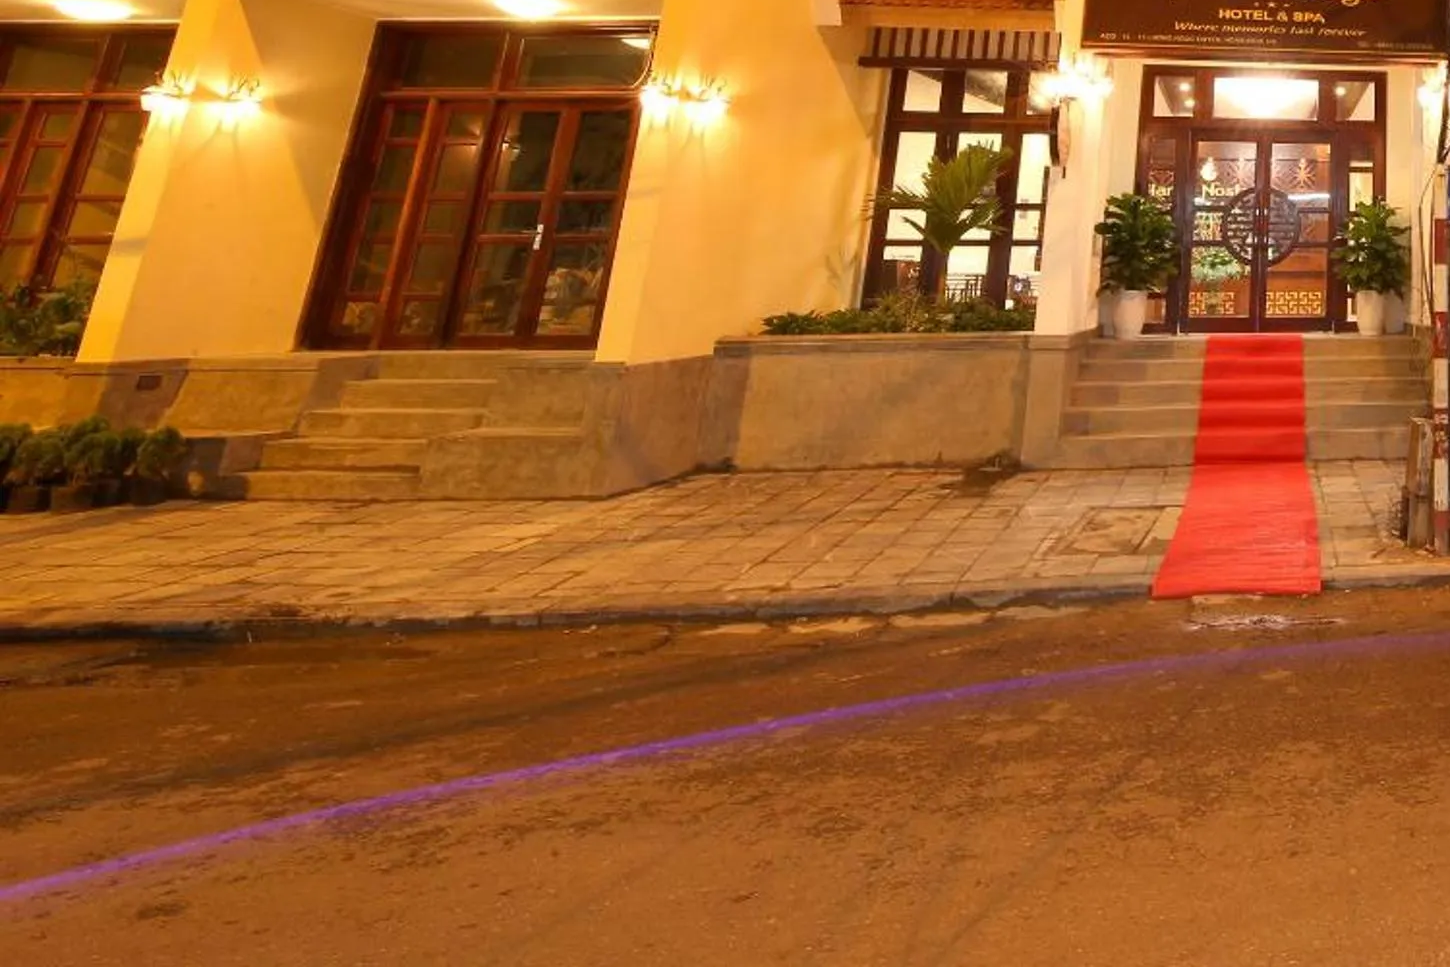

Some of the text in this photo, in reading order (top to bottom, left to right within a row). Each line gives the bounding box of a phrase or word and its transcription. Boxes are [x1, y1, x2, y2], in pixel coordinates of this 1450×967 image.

[1218, 8, 1326, 24] HOTEL & SPA
